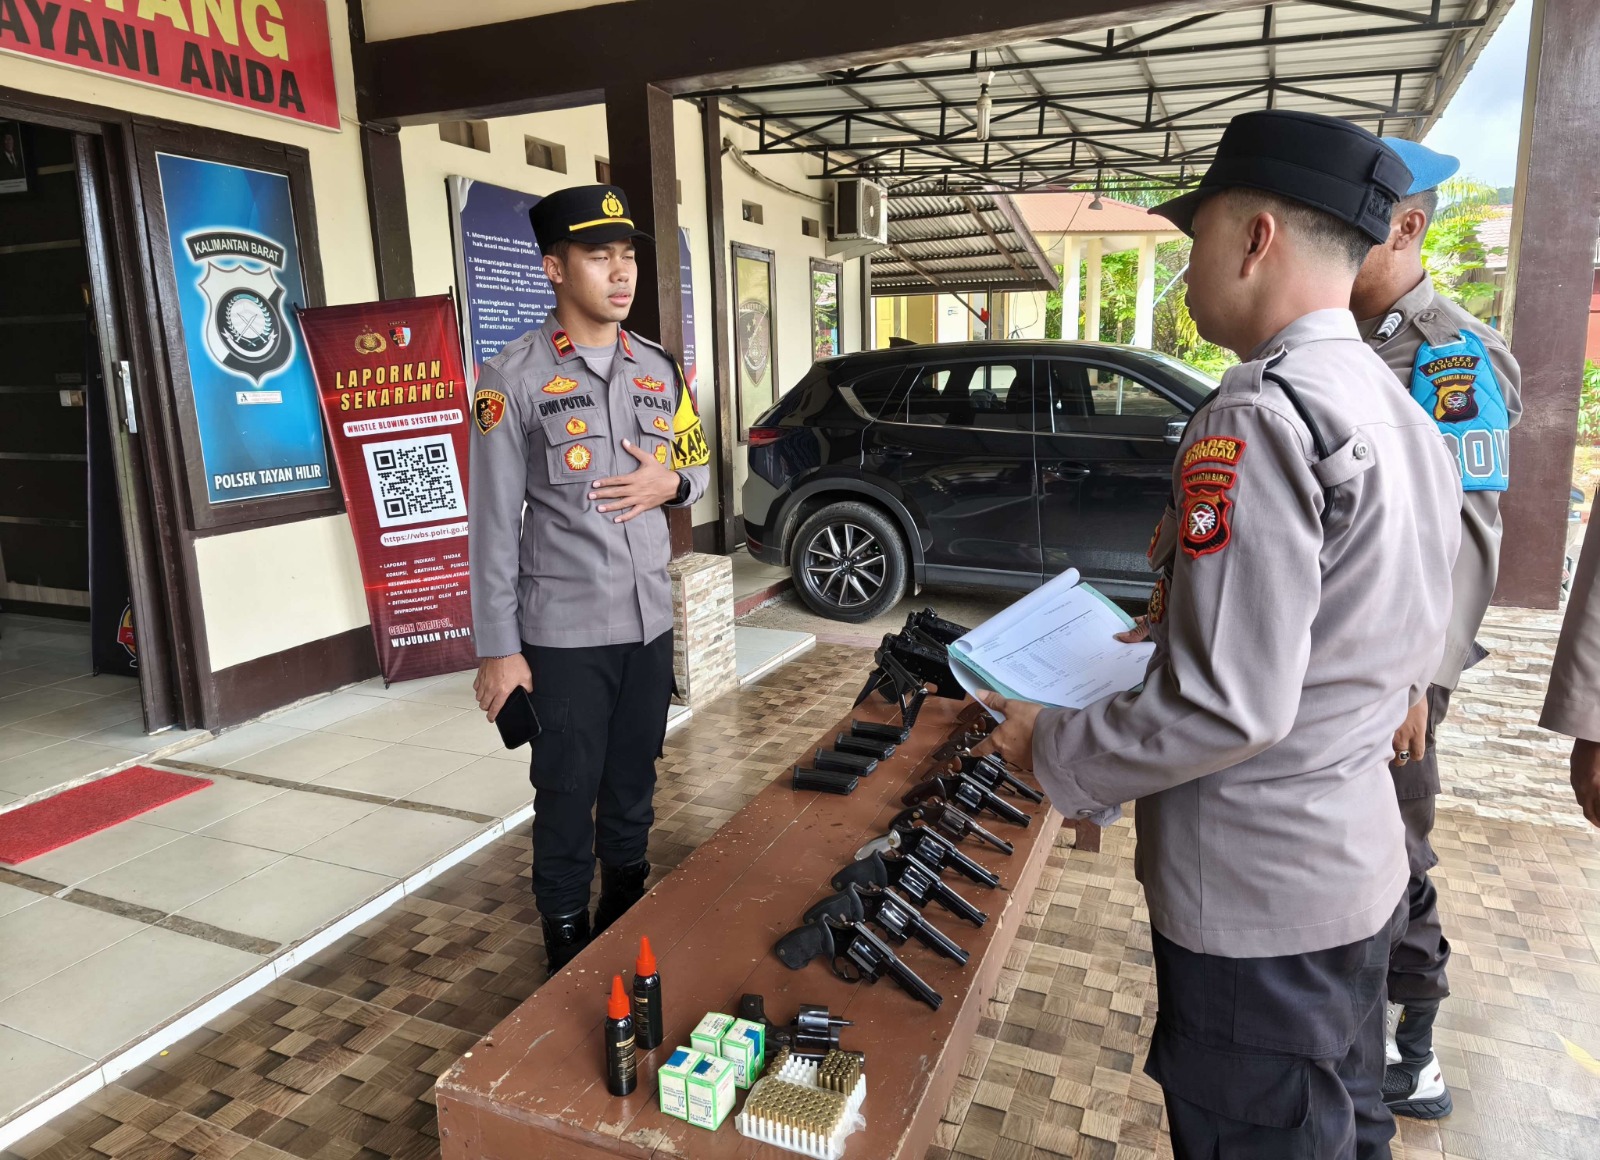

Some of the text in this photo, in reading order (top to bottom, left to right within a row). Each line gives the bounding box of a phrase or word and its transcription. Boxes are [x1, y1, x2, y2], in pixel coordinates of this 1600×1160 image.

[180, 41, 306, 113] ANDA
[194, 239, 279, 262] KALIMANTAN BARAT
[1430, 356, 1472, 368] POLRES
[336, 360, 441, 389] LAPORKAN
[341, 380, 454, 411] SEKARANG!
[560, 394, 595, 411] PUTRA
[633, 395, 672, 413] POLRI
[347, 412, 459, 433] WHISTLE BLOWING SYSTEM POLRI
[214, 464, 321, 490] POLSEK TAYAN HILIR
[388, 623, 415, 635] CEGAH
[391, 627, 471, 648] WUJUDKAN POLRI
